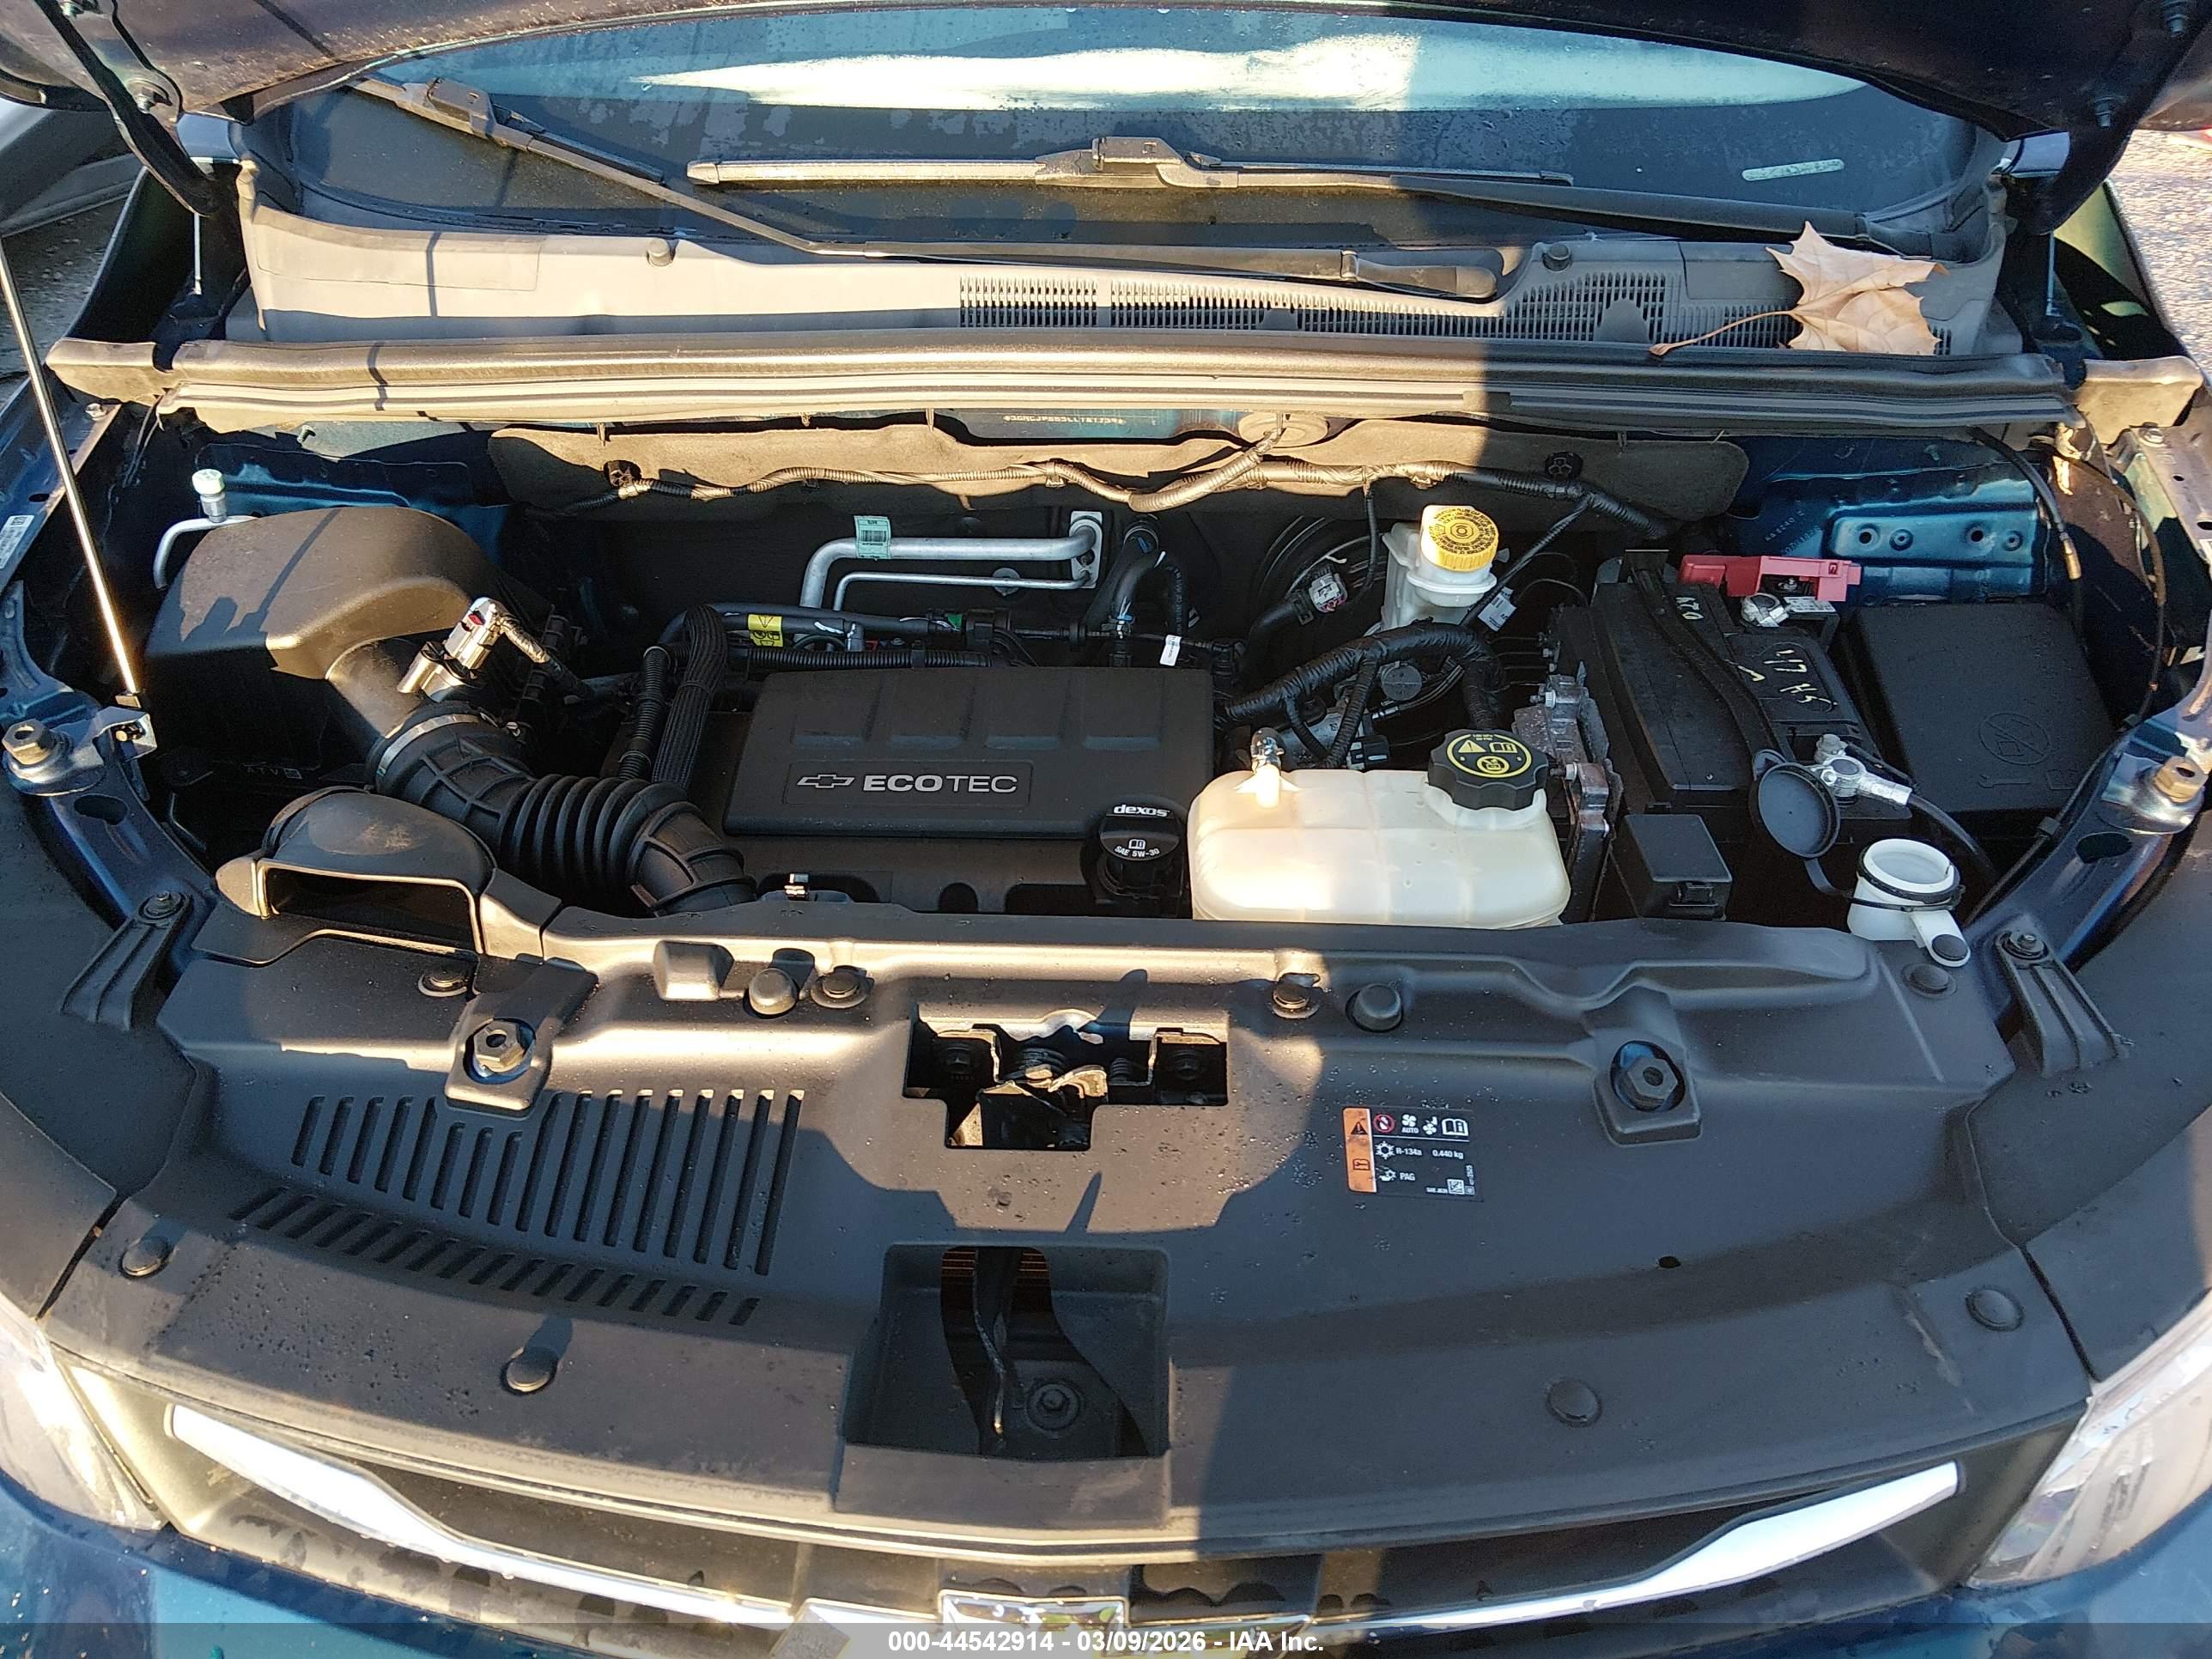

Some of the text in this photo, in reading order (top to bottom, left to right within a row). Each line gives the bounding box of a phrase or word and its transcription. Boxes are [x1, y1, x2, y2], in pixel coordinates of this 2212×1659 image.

[863, 775, 1018, 793] ECOTEC
[1113, 804, 1170, 817] dexos
[1115, 846, 1160, 858] SAE 5W-30
[1395, 1146, 1464, 1159] R-134a 0.440 kg
[1400, 1172, 1416, 1181] PAG
